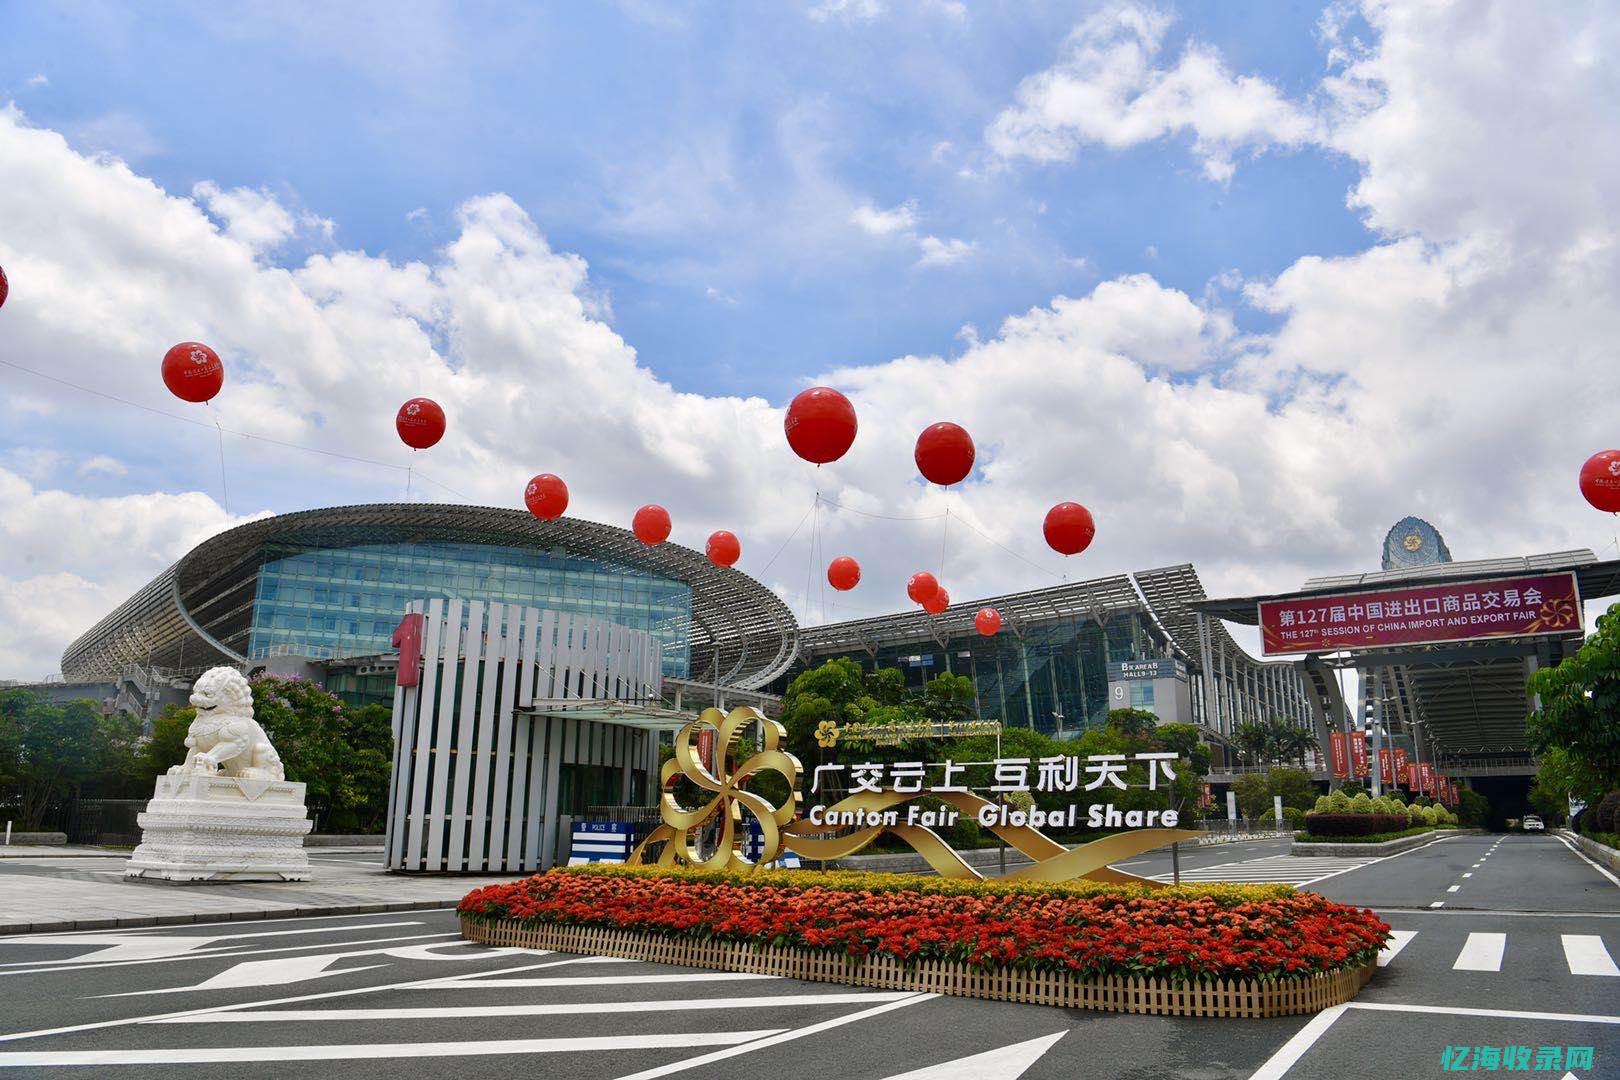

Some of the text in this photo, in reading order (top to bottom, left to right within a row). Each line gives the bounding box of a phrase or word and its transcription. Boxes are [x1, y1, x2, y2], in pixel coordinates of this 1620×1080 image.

[1279, 587, 1543, 628] 第127届中国进出口商品交易会
[1281, 631, 1298, 640] THE
[1321, 625, 1361, 637] SESSION
[1362, 624, 1375, 634] OF
[1377, 621, 1407, 632] CHINA
[1409, 618, 1446, 630] IMPORT
[1447, 616, 1468, 627] AND
[1471, 612, 1511, 625] EXPORT
[1513, 610, 1537, 622] FAIR
[392, 612, 424, 687] 1
[1115, 686, 1124, 700] 9
[811, 752, 1179, 794] 广交云上 互利天下
[809, 803, 1179, 828] Canton Fair Global Share
